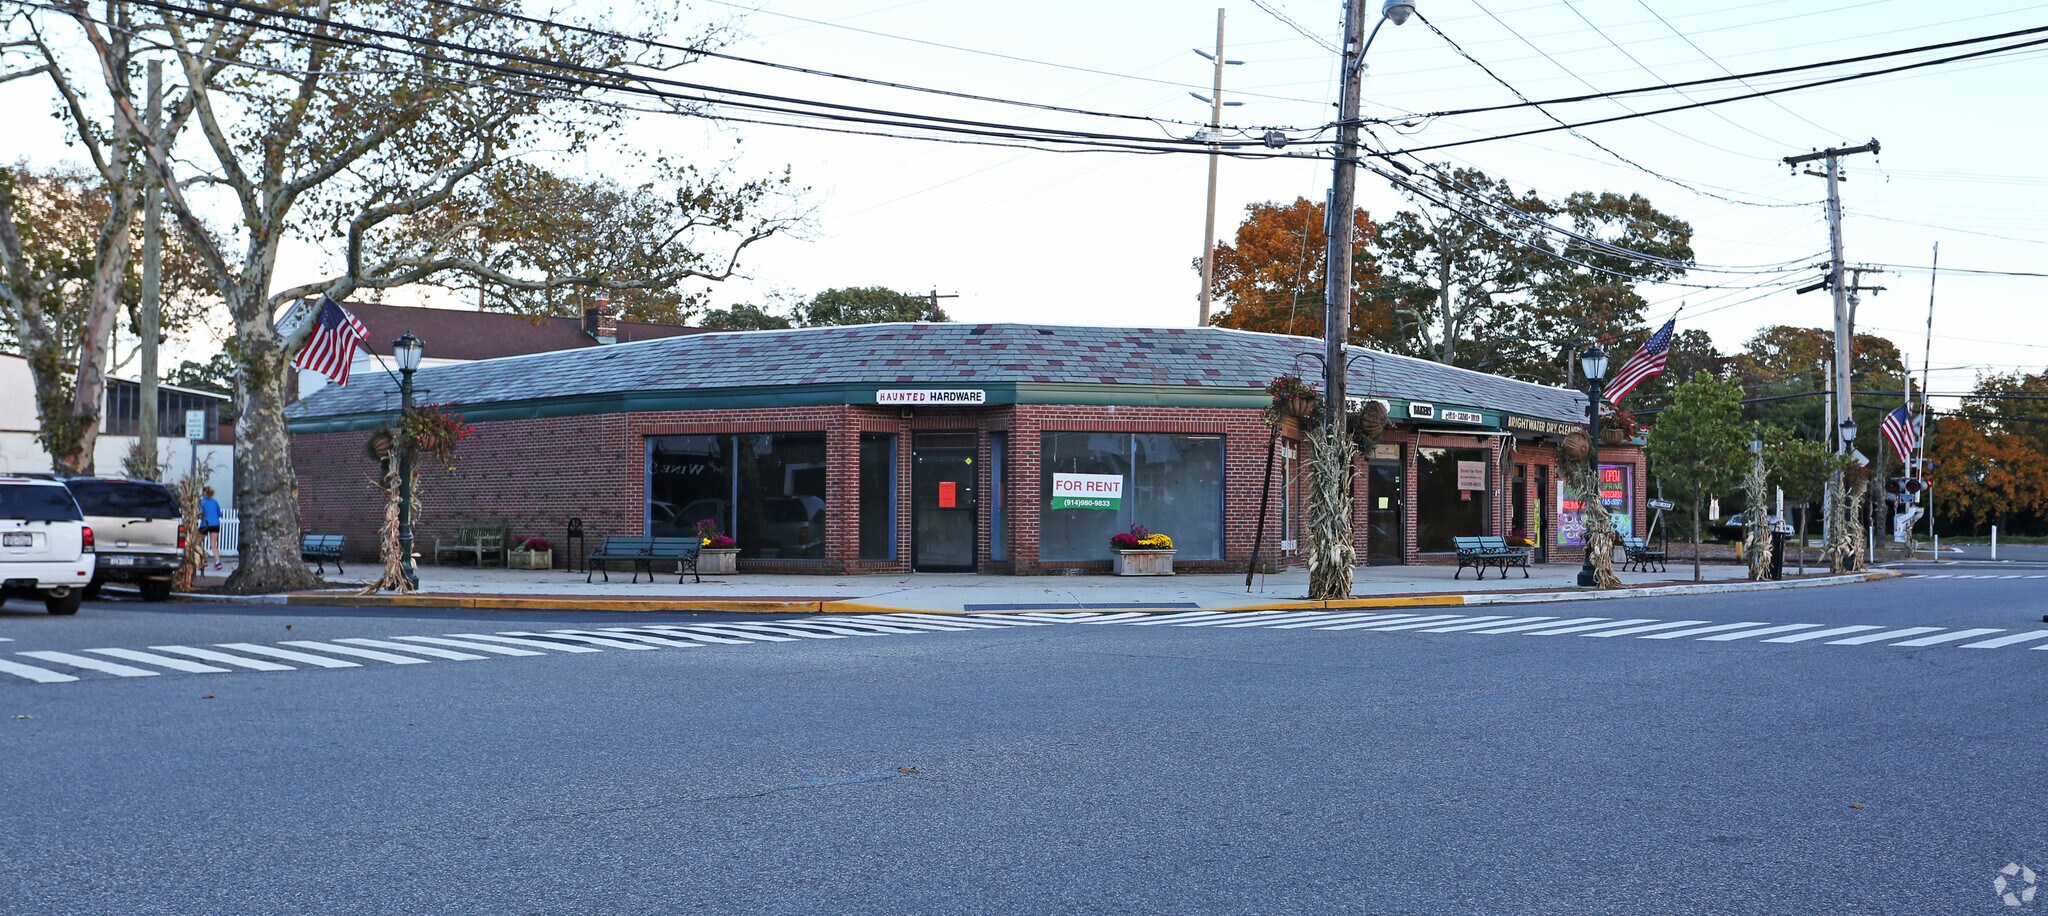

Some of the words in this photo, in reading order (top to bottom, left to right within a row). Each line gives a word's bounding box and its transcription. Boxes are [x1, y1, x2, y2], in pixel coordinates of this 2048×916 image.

[879, 392, 926, 402] HAUNTED
[929, 391, 982, 402] HARDWARE
[1507, 416, 1546, 432] BRIGHTWATER
[1605, 469, 1621, 482] OPEN
[1055, 480, 1083, 491] FOR
[1086, 481, 1121, 492] RENT
[1063, 499, 1111, 507] (914)980-9833
